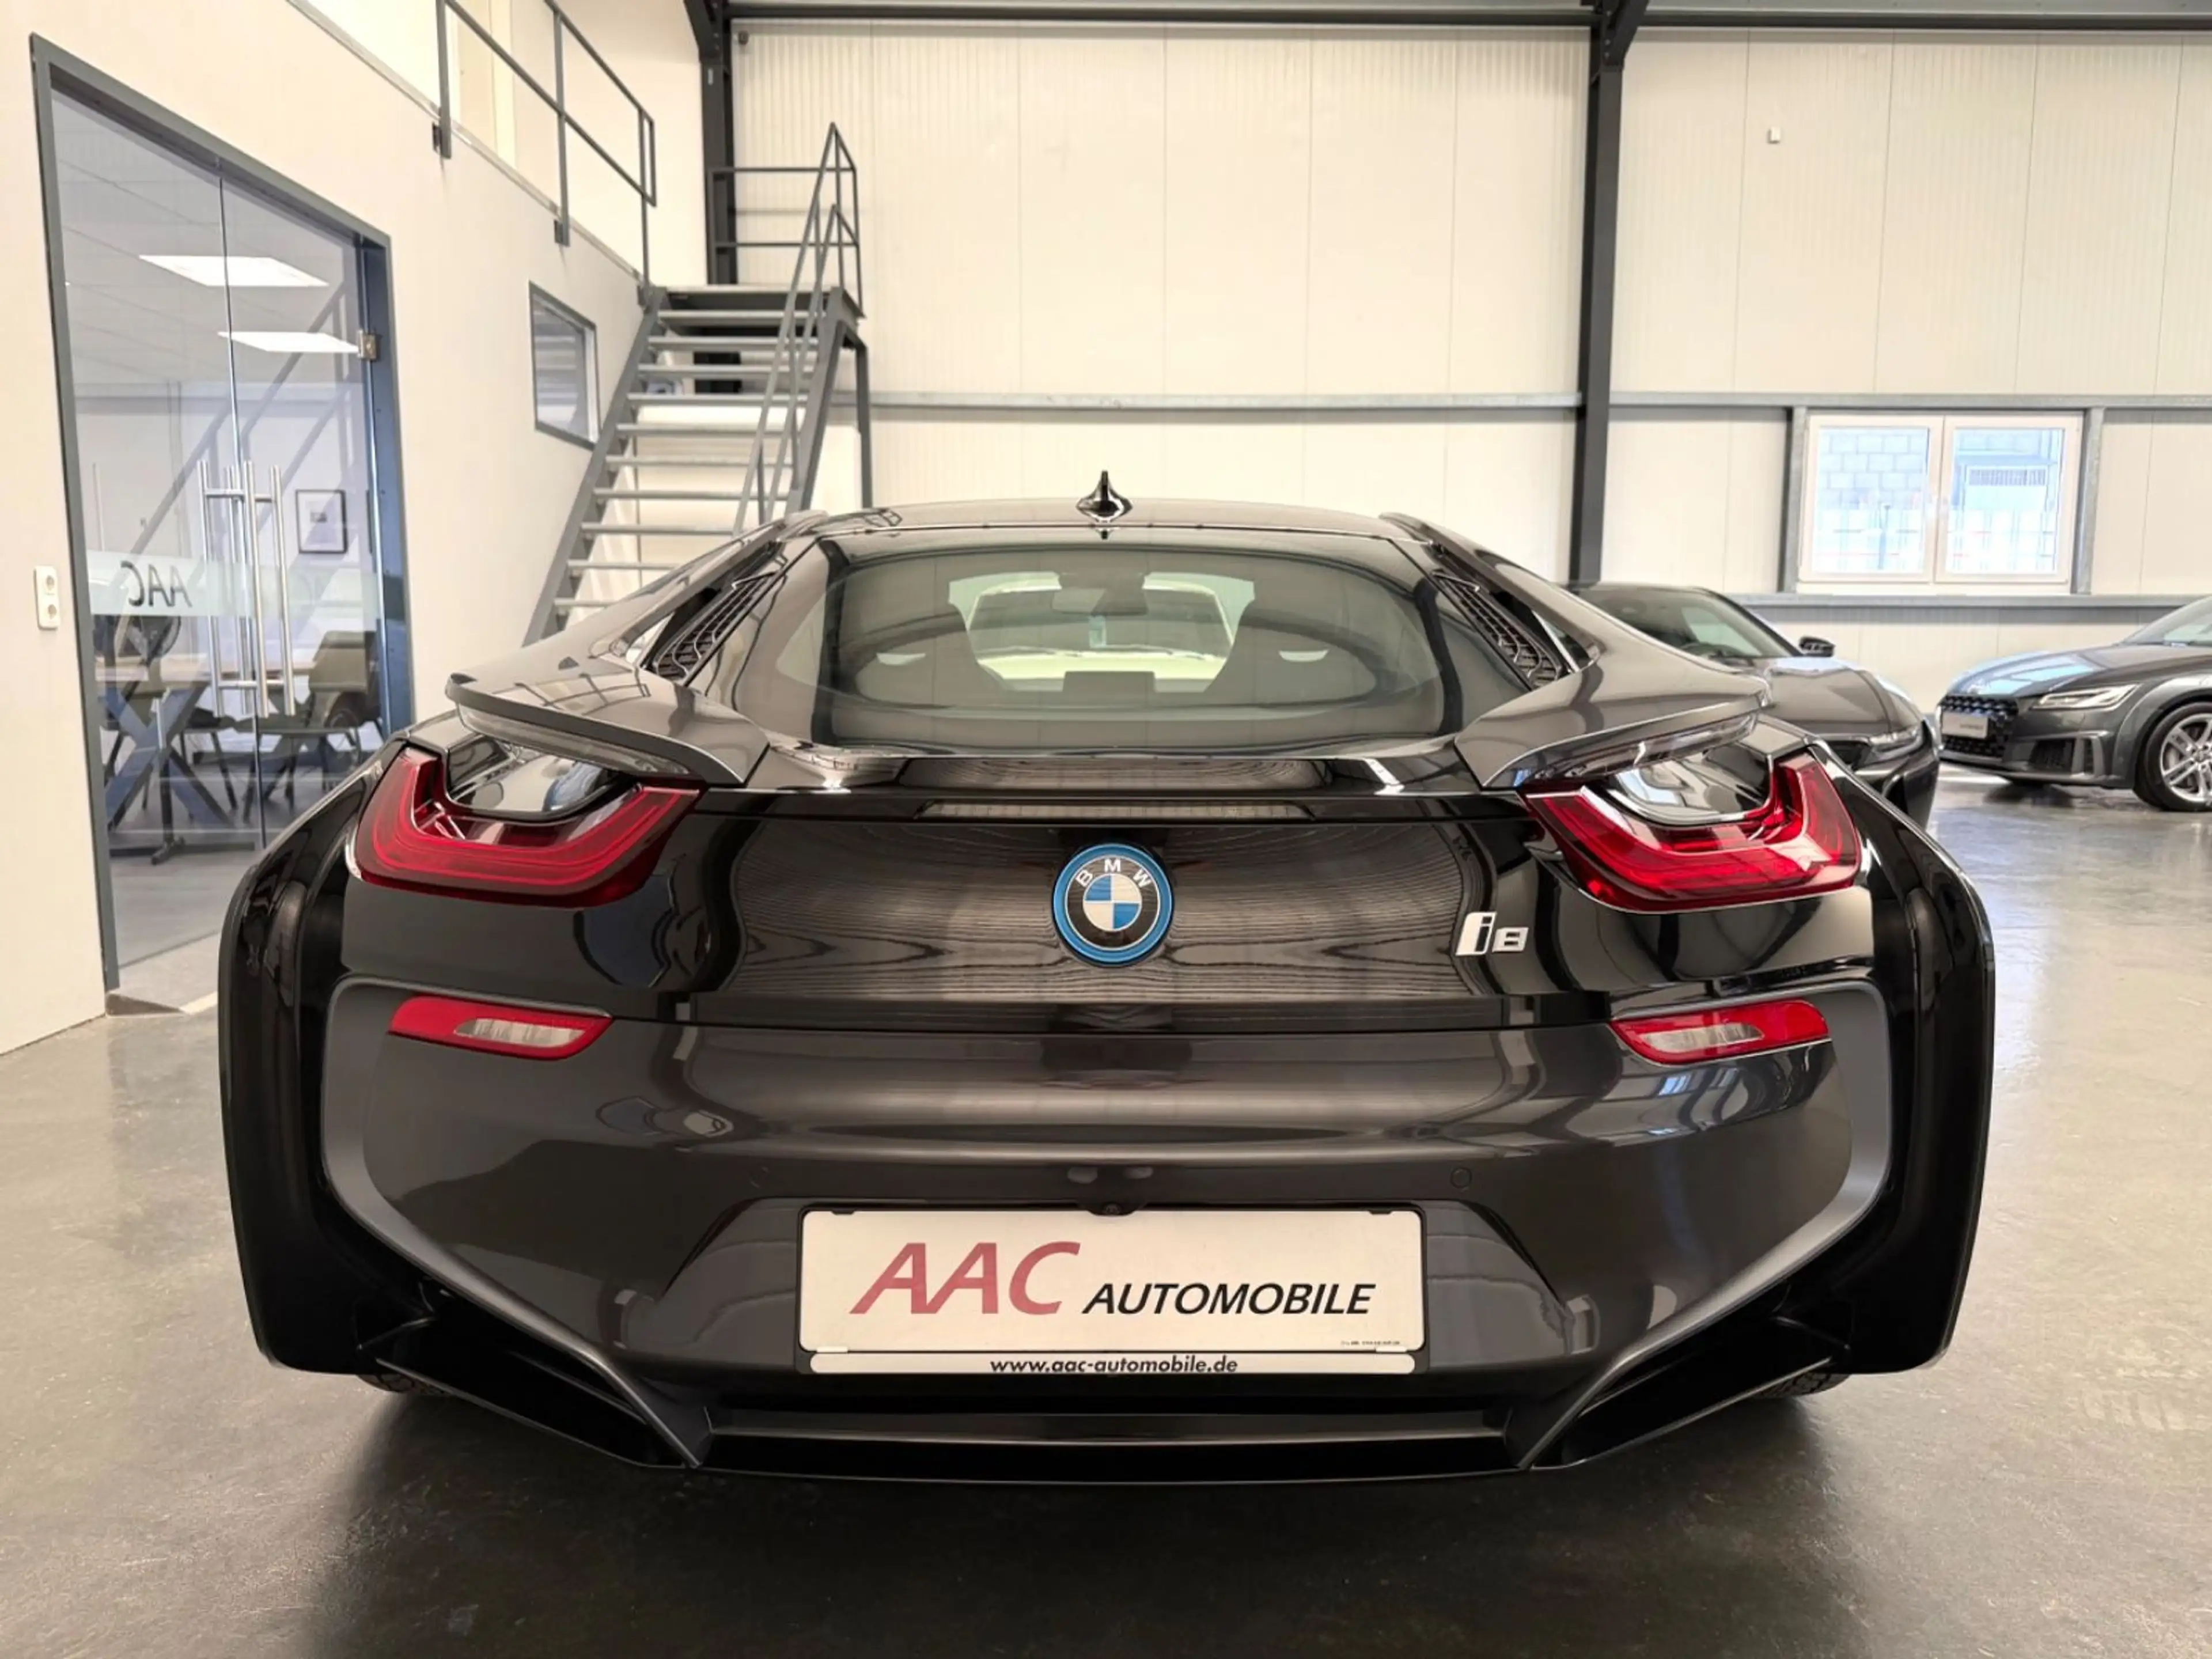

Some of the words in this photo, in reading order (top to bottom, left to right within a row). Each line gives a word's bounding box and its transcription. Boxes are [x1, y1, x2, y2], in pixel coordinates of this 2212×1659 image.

[1075, 858, 1151, 888] BMW
[1455, 911, 1529, 956] i8
[850, 1241, 1081, 1315] AAC
[1081, 1282, 1376, 1315] AUTOMOBILE
[990, 1355, 1238, 1373] www.aac-automobile.de
